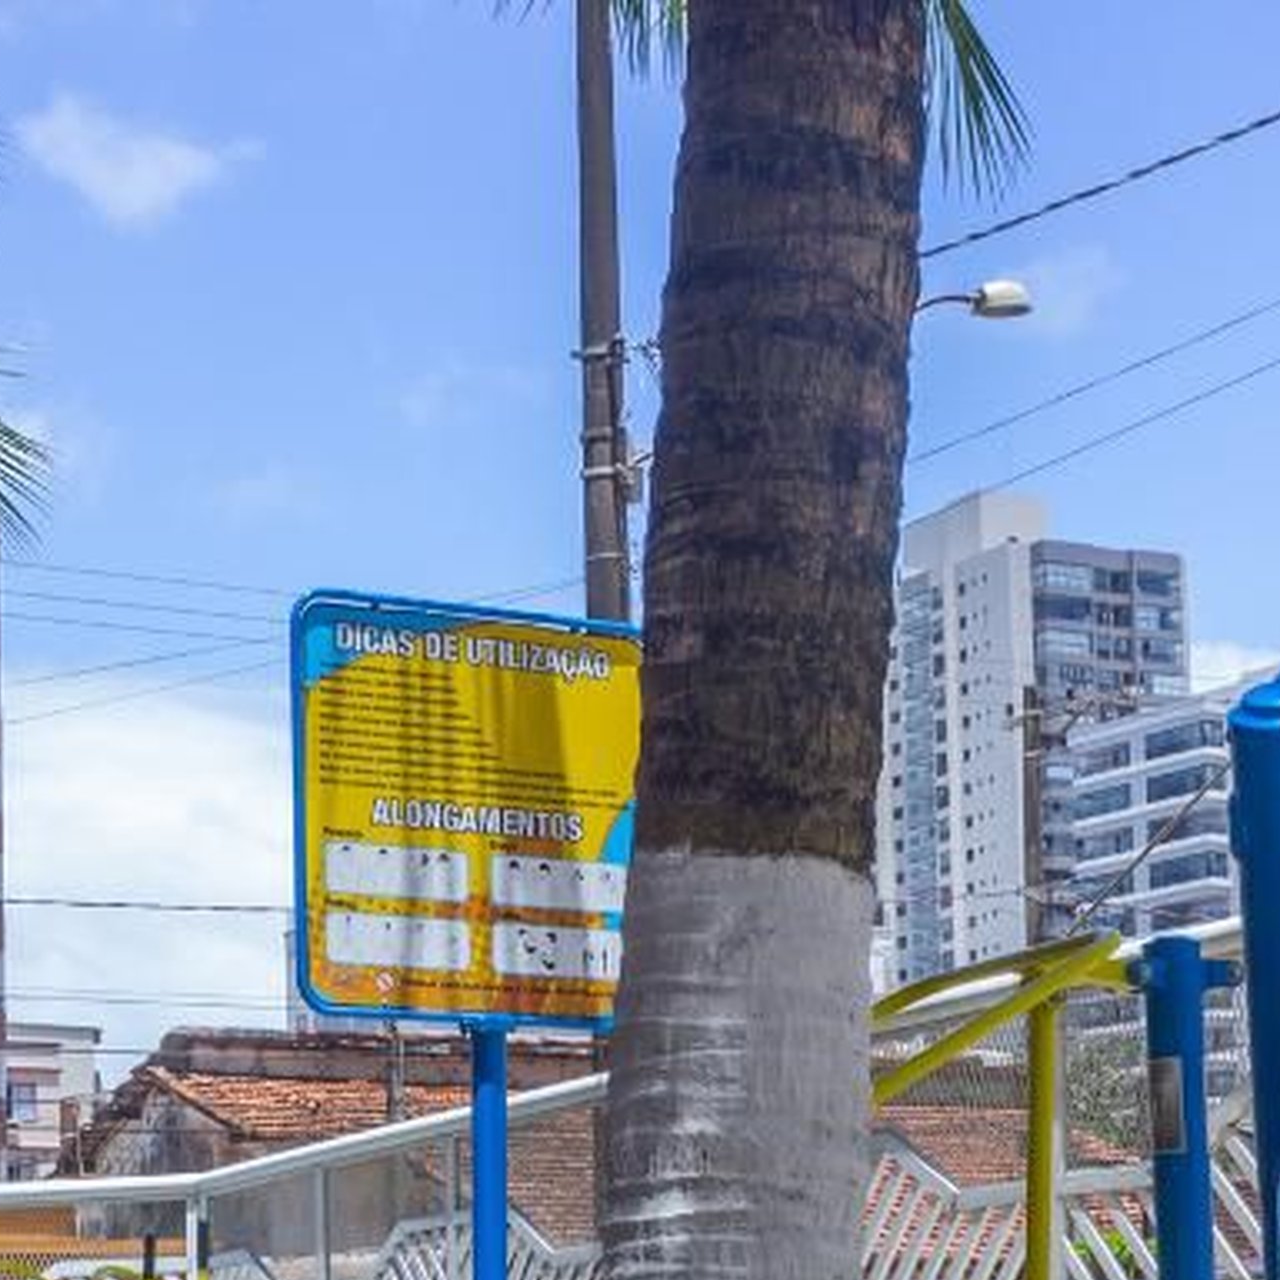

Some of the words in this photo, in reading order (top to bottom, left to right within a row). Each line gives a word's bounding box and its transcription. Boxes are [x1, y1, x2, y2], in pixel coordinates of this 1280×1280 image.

[335, 621, 415, 657] DICAS
[425, 632, 459, 661] DE
[467, 638, 611, 682] UTILIZAÇÃO
[372, 798, 584, 841] ALONGAMENTOS
